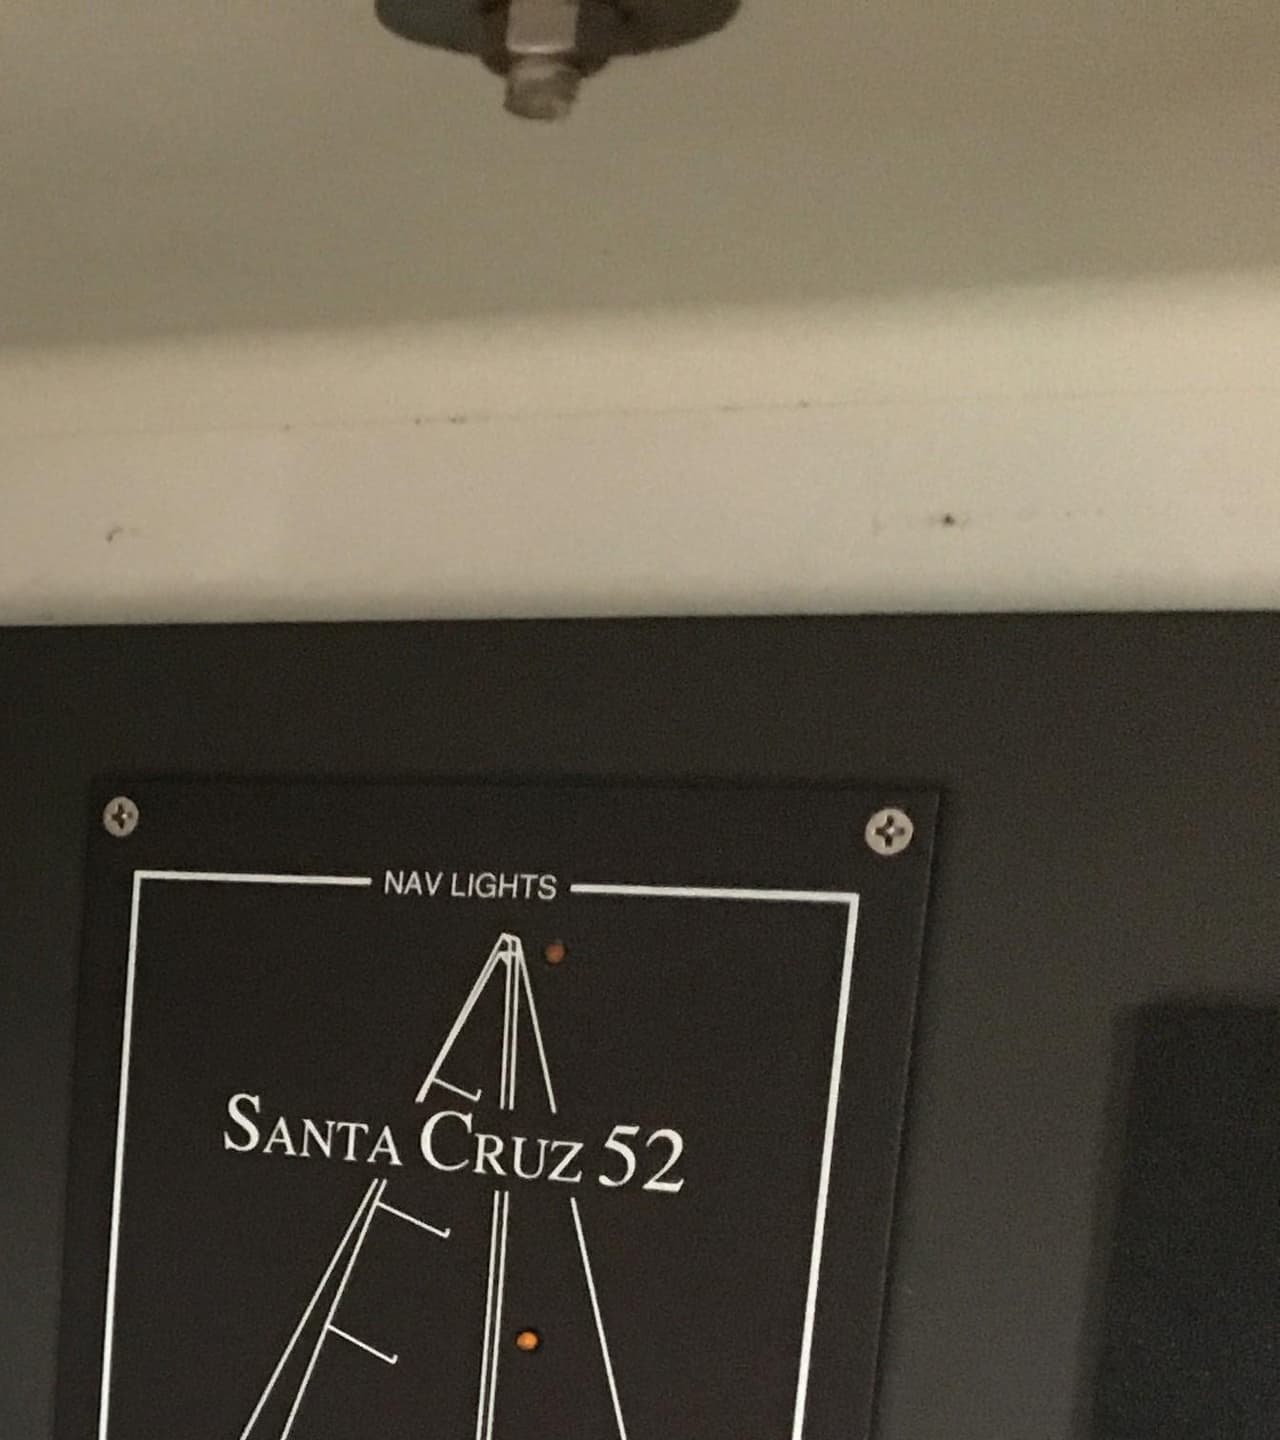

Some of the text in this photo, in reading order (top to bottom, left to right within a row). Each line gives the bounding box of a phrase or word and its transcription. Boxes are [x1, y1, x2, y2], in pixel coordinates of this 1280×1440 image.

[383, 869, 558, 901] NAV LIGHTS
[223, 1092, 687, 1193] SANTA CRUZ 52
